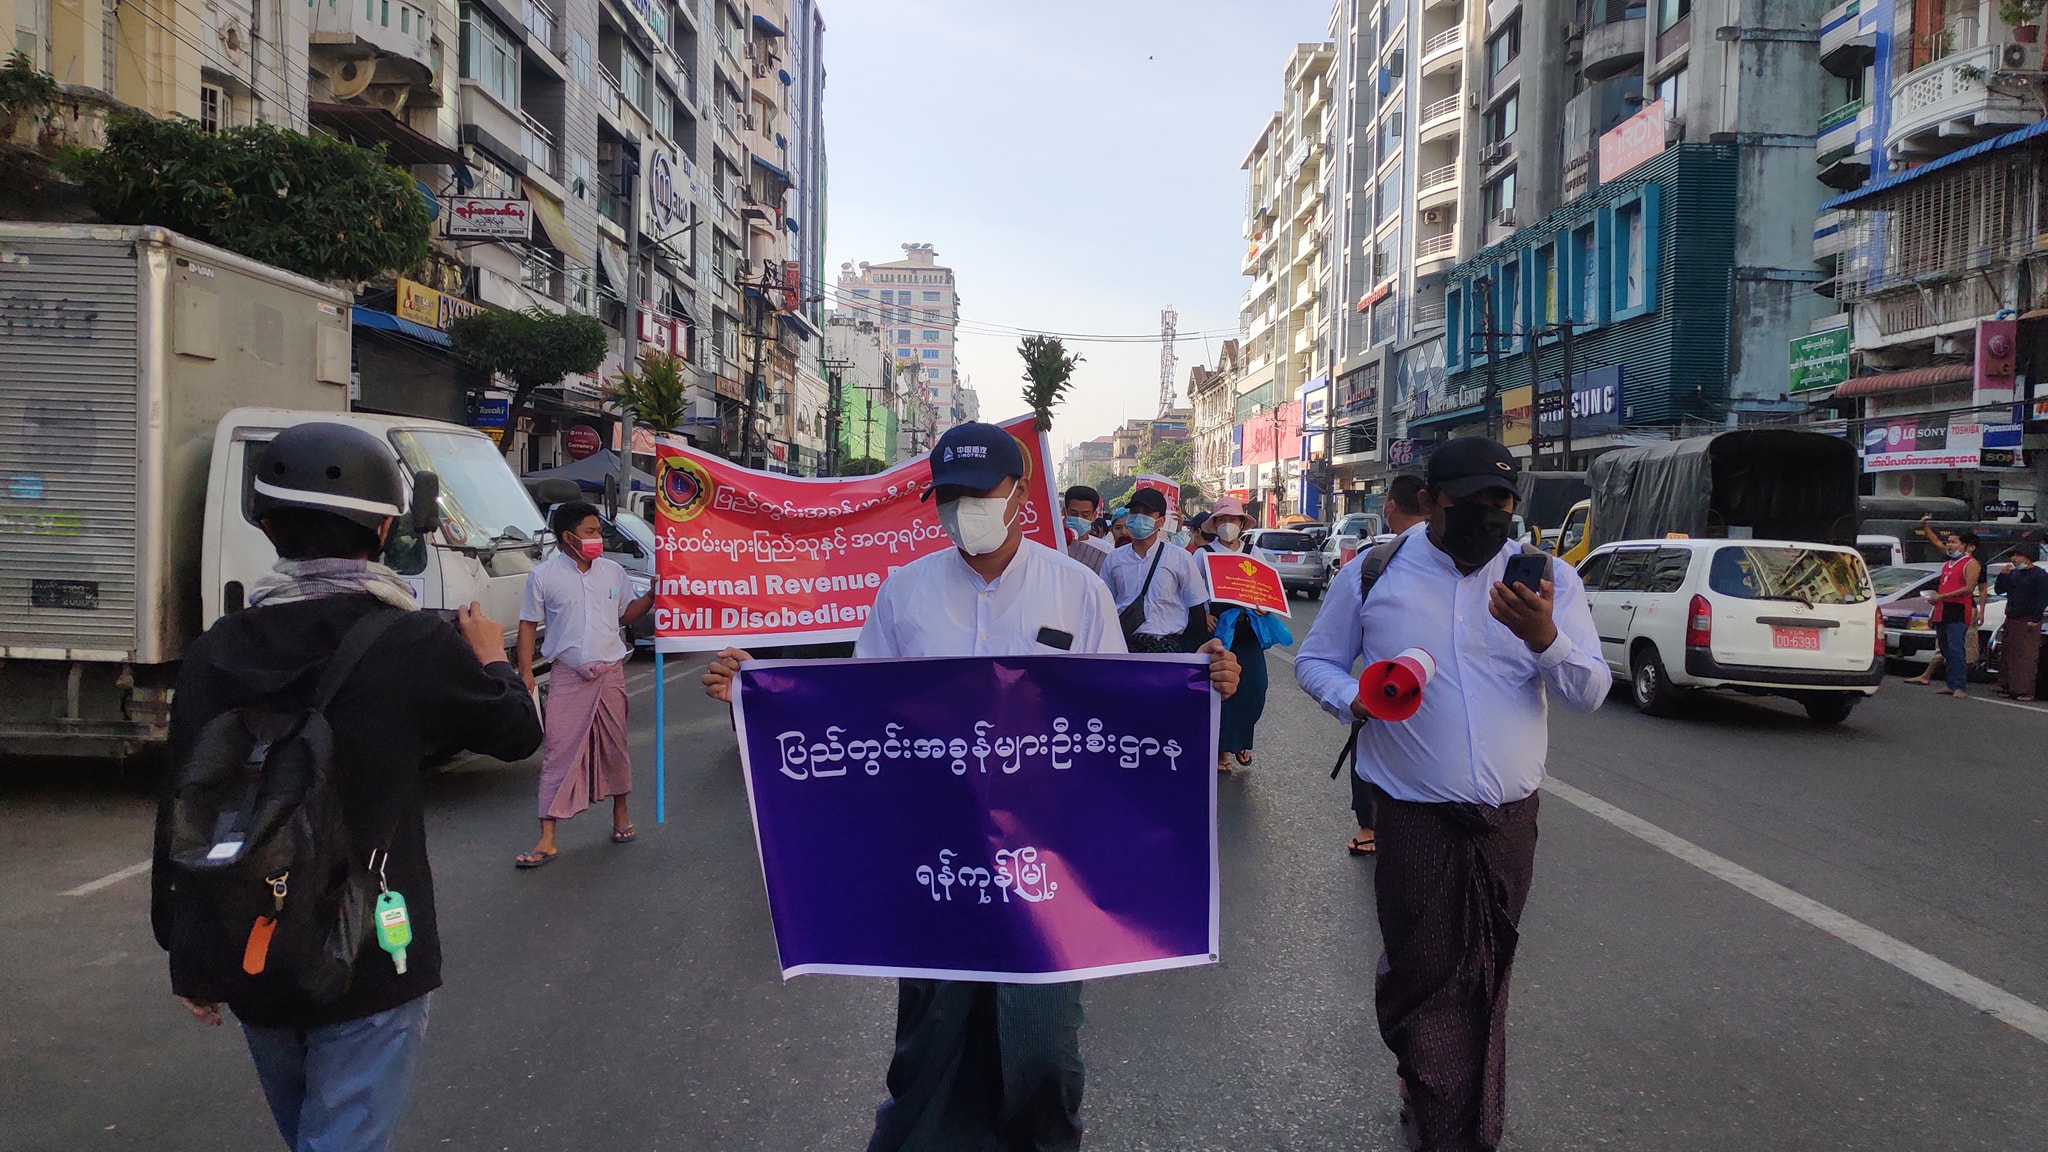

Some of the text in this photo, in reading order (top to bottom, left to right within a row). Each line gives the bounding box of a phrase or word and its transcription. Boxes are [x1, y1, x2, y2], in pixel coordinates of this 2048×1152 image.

[1616, 109, 1661, 154] IRON
[1902, 427, 1916, 440] LG
[1917, 427, 1947, 438] SONY
[1952, 425, 1980, 434] TOSHIBA
[1984, 423, 2021, 433] Panasonic
[568, 442, 595, 450] Currency
[1254, 425, 1288, 452] SHAP
[1985, 504, 2016, 512] CANAL+
[655, 571, 881, 597] Internal Revenue
[655, 603, 871, 631] Civil Disobedien
[776, 716, 1183, 780] ပြည်တွင်းအခွန်များဦးစီးဌာန
[915, 846, 1059, 904] ရန်ကုန်မြို့
